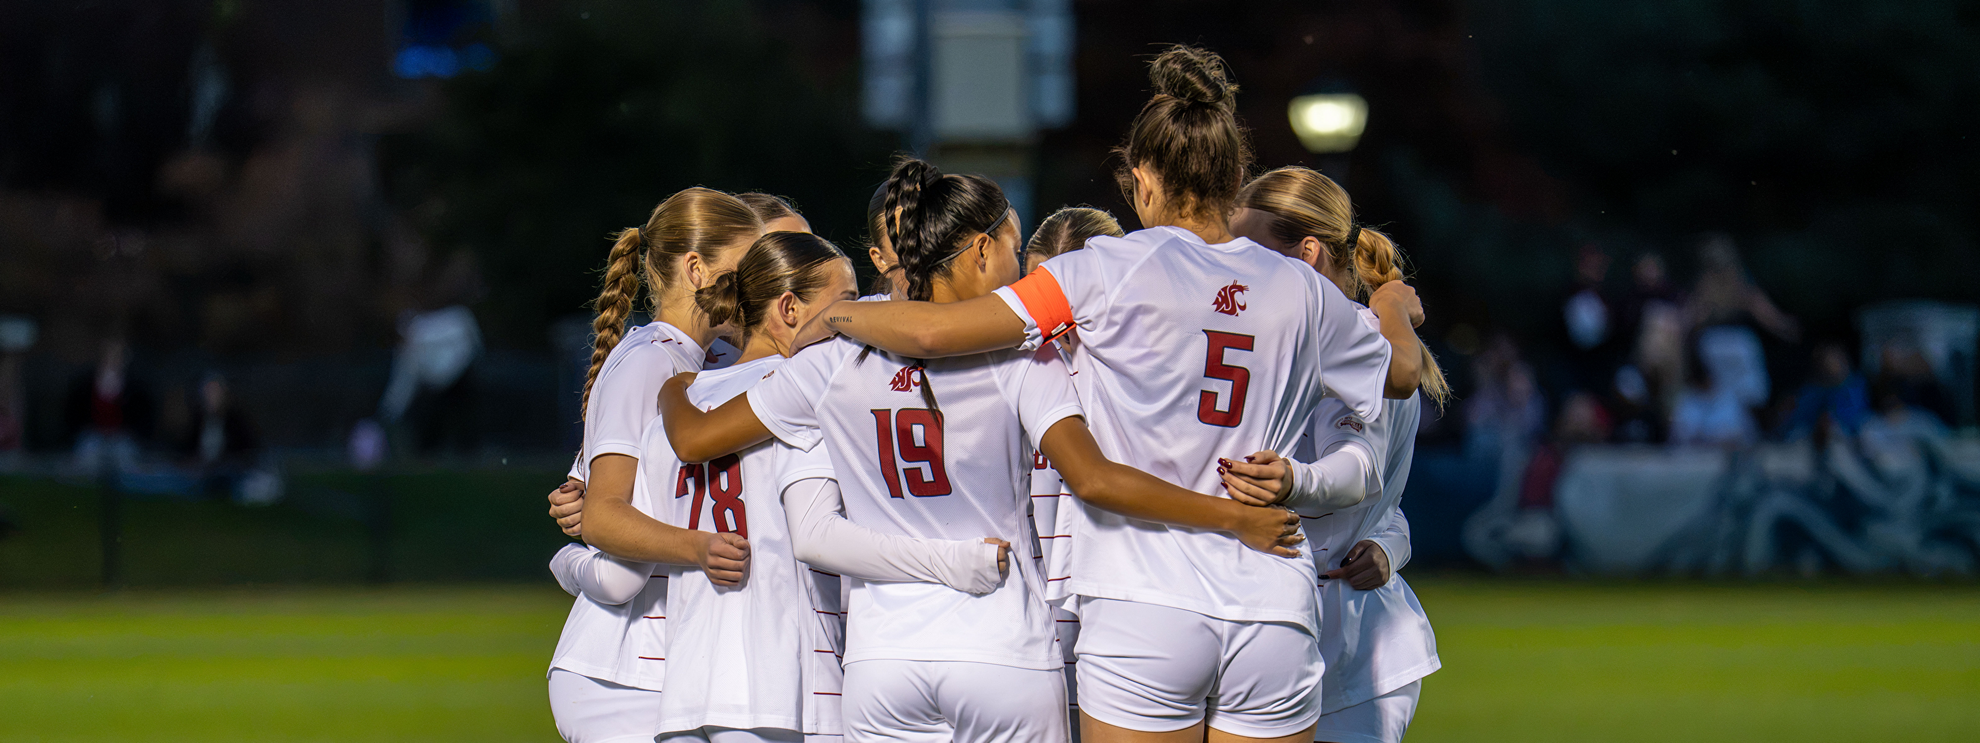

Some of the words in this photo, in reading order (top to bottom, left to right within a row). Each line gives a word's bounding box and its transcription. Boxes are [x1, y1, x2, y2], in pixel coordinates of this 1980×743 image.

[1197, 329, 1255, 428] 5
[675, 453, 748, 540] 78
[870, 408, 952, 499] 19
